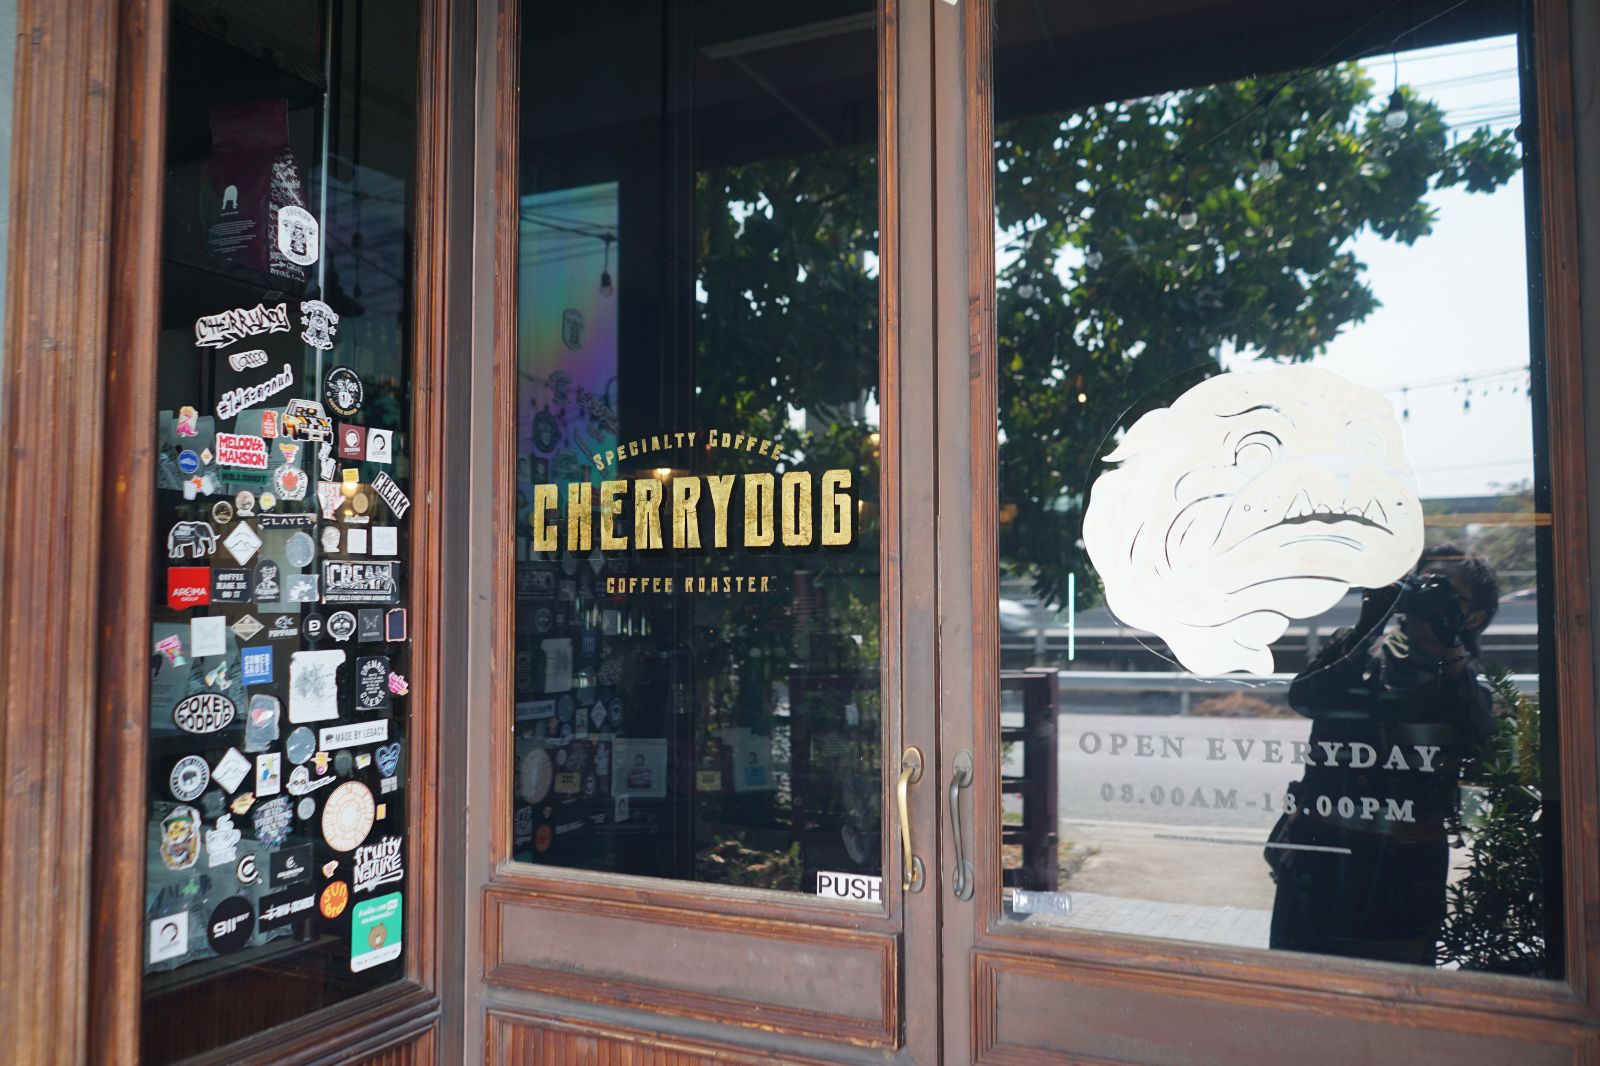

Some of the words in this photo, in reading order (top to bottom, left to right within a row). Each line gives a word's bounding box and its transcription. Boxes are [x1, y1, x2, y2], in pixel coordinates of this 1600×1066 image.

[373, 473, 408, 515] CREAM
[533, 469, 852, 551] CHERRYDOG
[262, 516, 313, 526] SLAYER
[327, 564, 390, 586] CREAM
[606, 577, 673, 594] COFFEE
[685, 576, 770, 593] ROASTER
[171, 586, 208, 597] AROMA
[178, 696, 231, 714] POKER
[335, 729, 352, 742] MADE
[354, 728, 362, 739] BY
[363, 725, 385, 738] LEGACY
[1079, 731, 1186, 759] OPEN
[1205, 737, 1441, 773] EVERYDAY
[818, 875, 882, 900] PUSH
